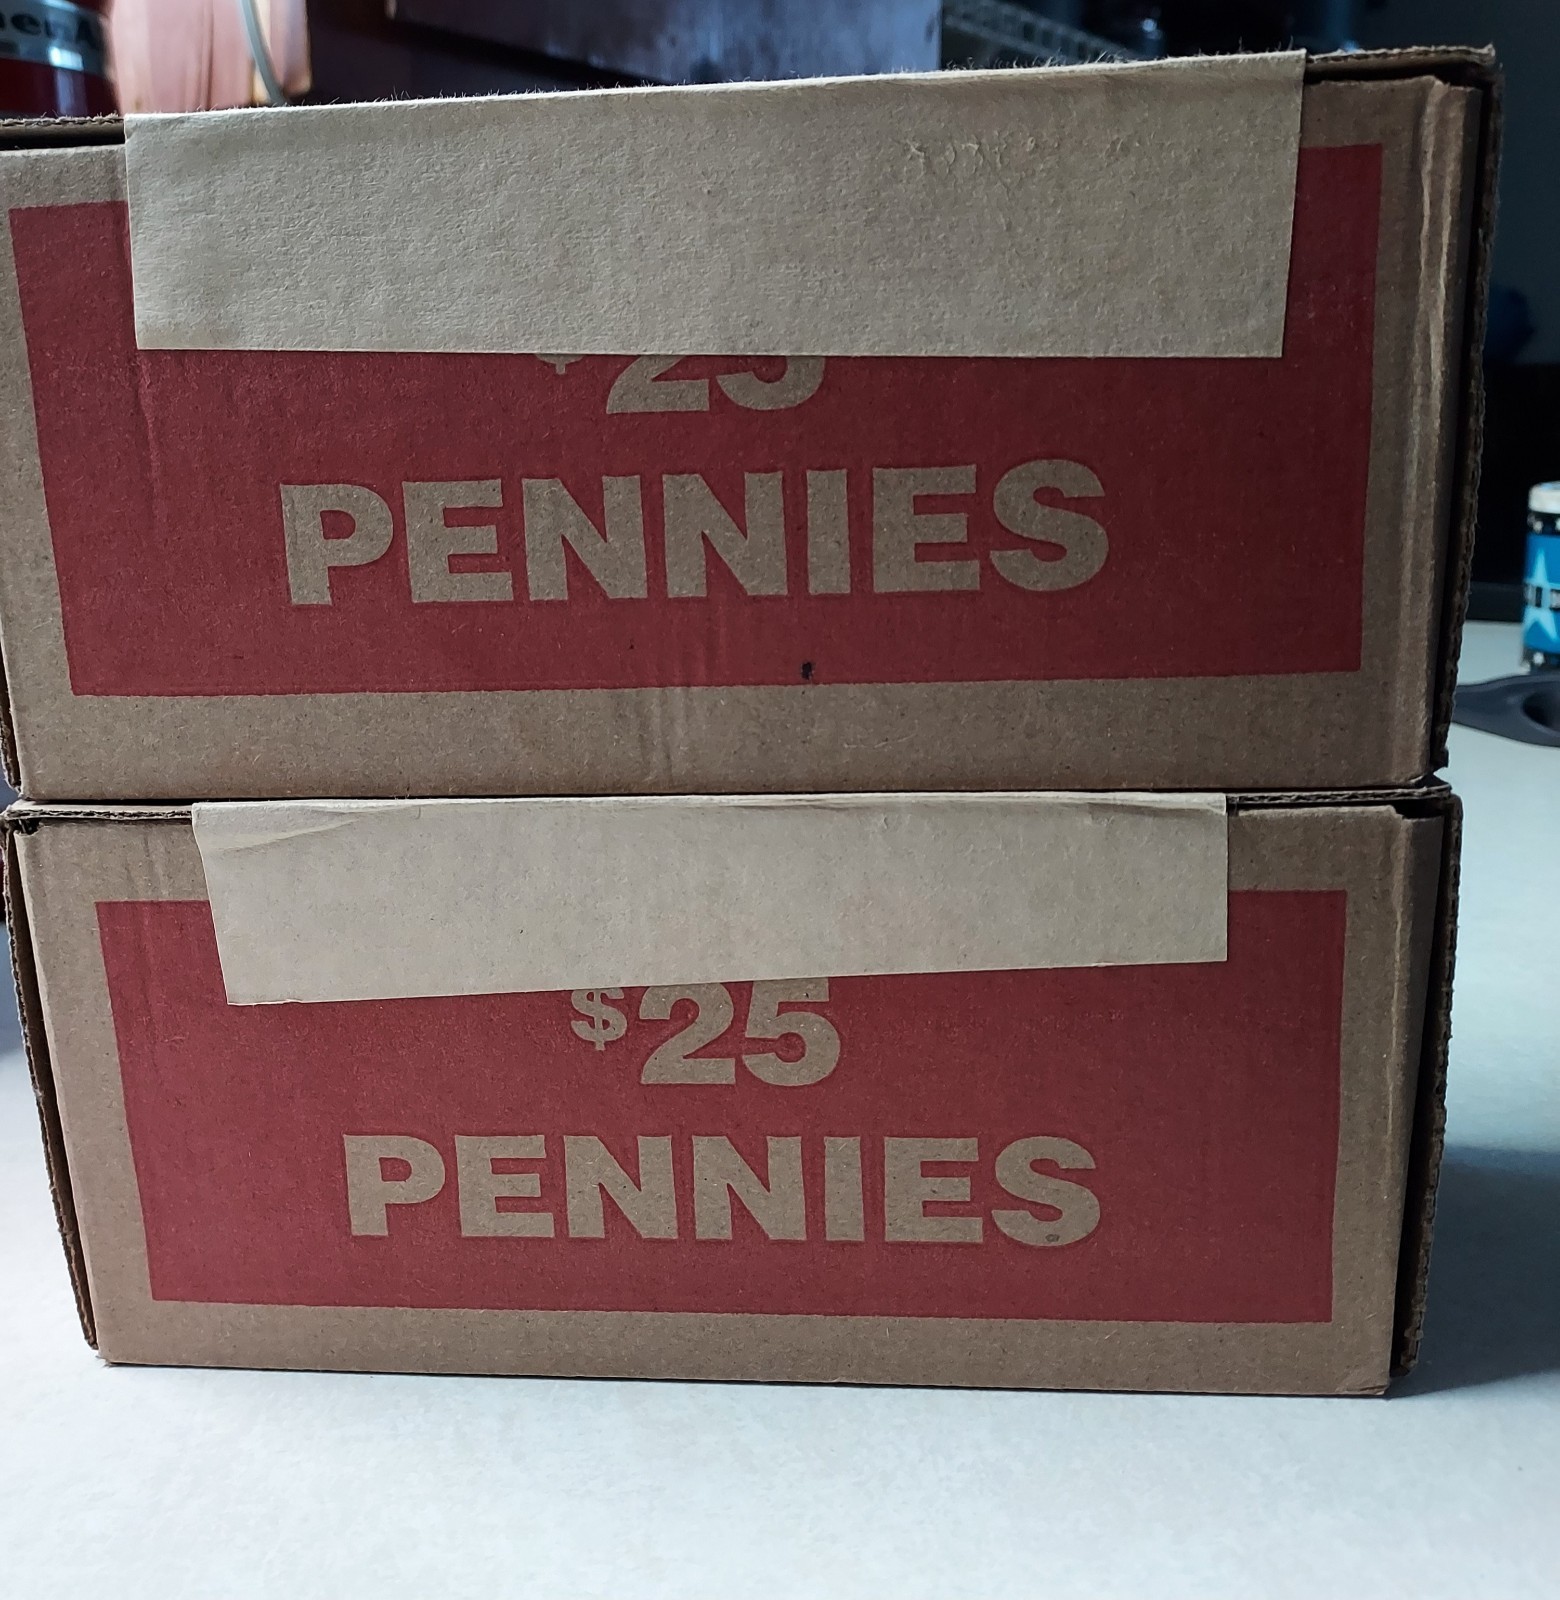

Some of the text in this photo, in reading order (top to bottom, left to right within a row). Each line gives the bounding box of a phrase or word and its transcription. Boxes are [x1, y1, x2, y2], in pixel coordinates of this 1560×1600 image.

[534, 353, 826, 414] 25
[280, 460, 1109, 606] PENNIES
[570, 977, 841, 1087] $25
[344, 1134, 1101, 1247] PENNIES
